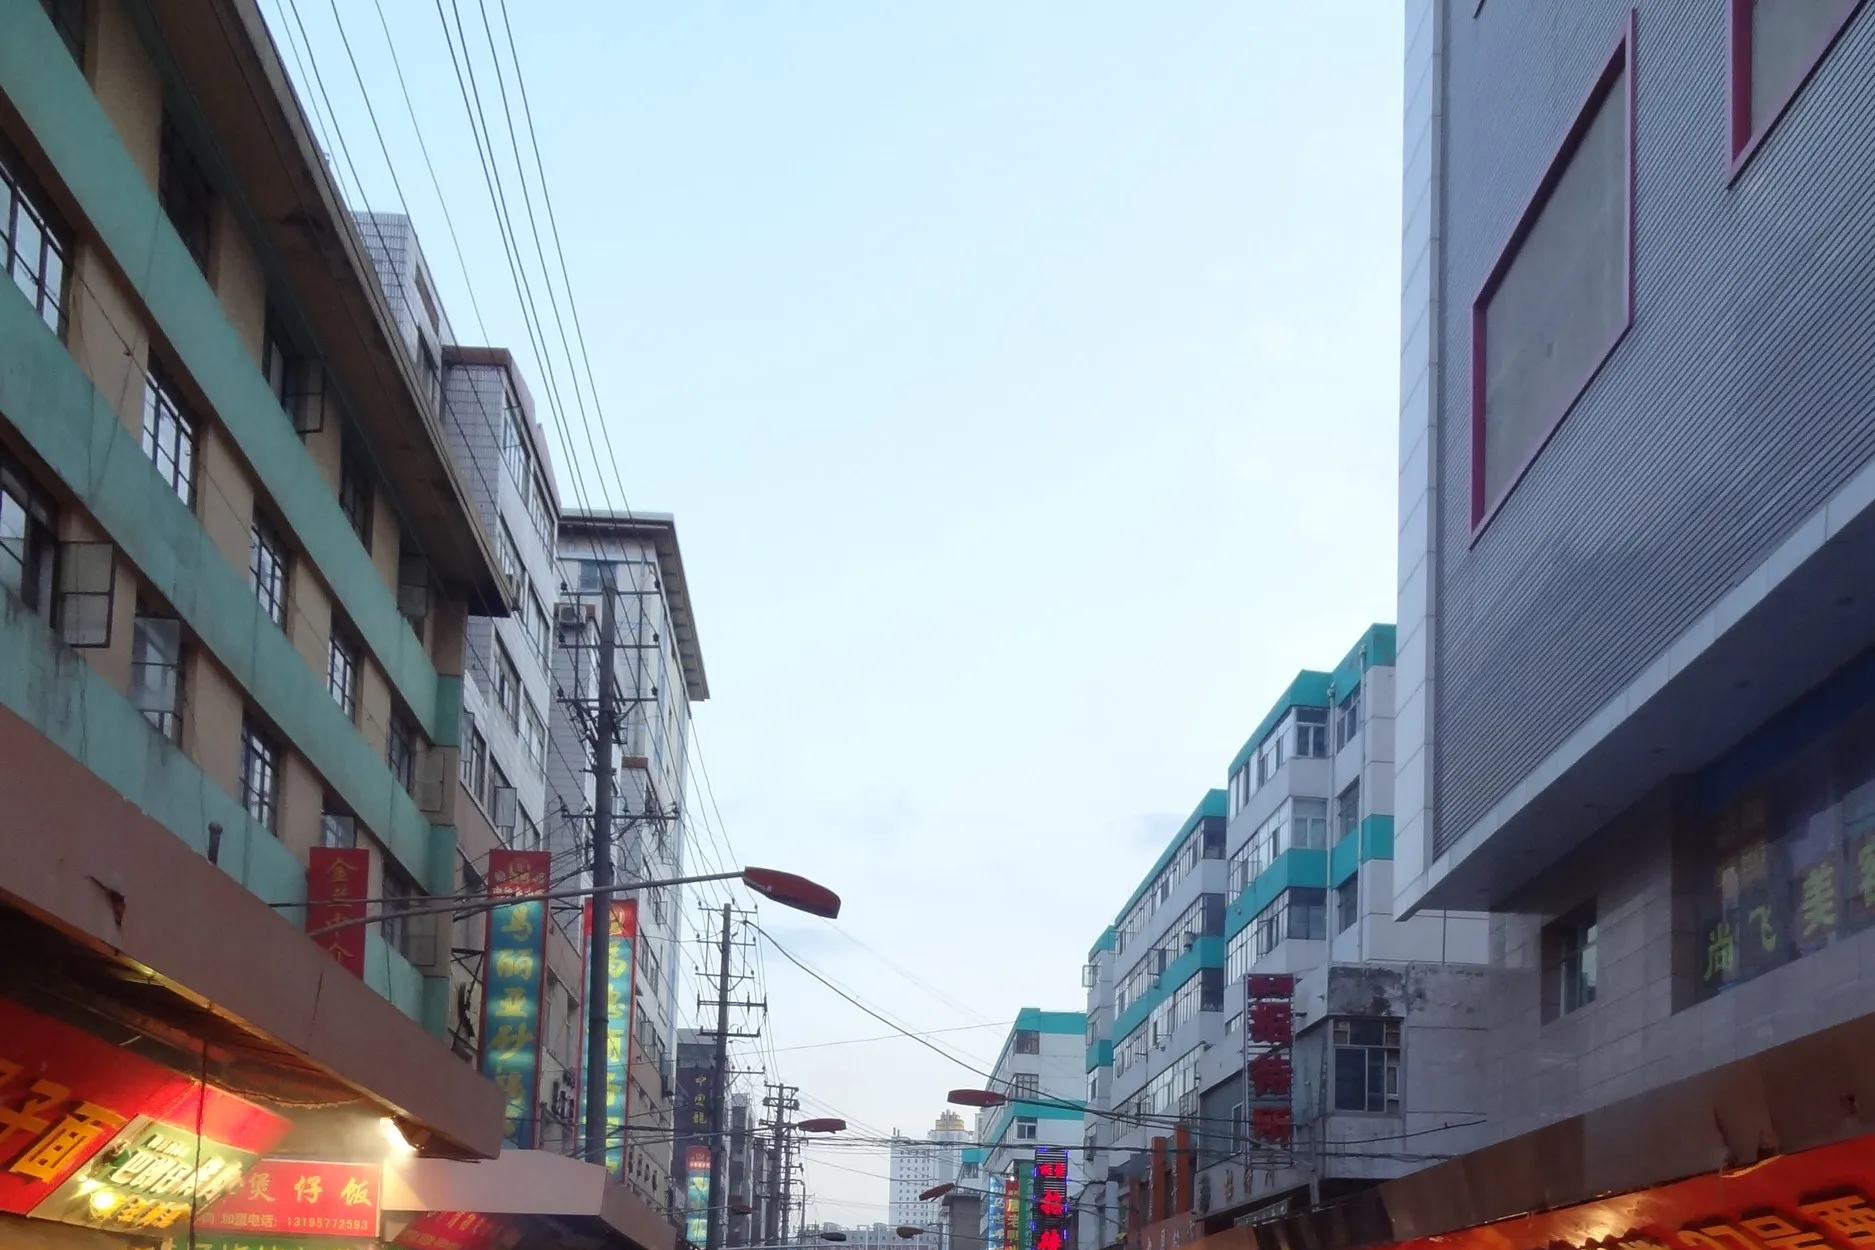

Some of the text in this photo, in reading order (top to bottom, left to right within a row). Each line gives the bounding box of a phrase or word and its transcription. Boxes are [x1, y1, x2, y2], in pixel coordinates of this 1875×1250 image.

[0, 1058, 129, 1184] 子面
[228, 1172, 374, 1207] 煲仔饭
[287, 1217, 369, 1231] 13195772593
